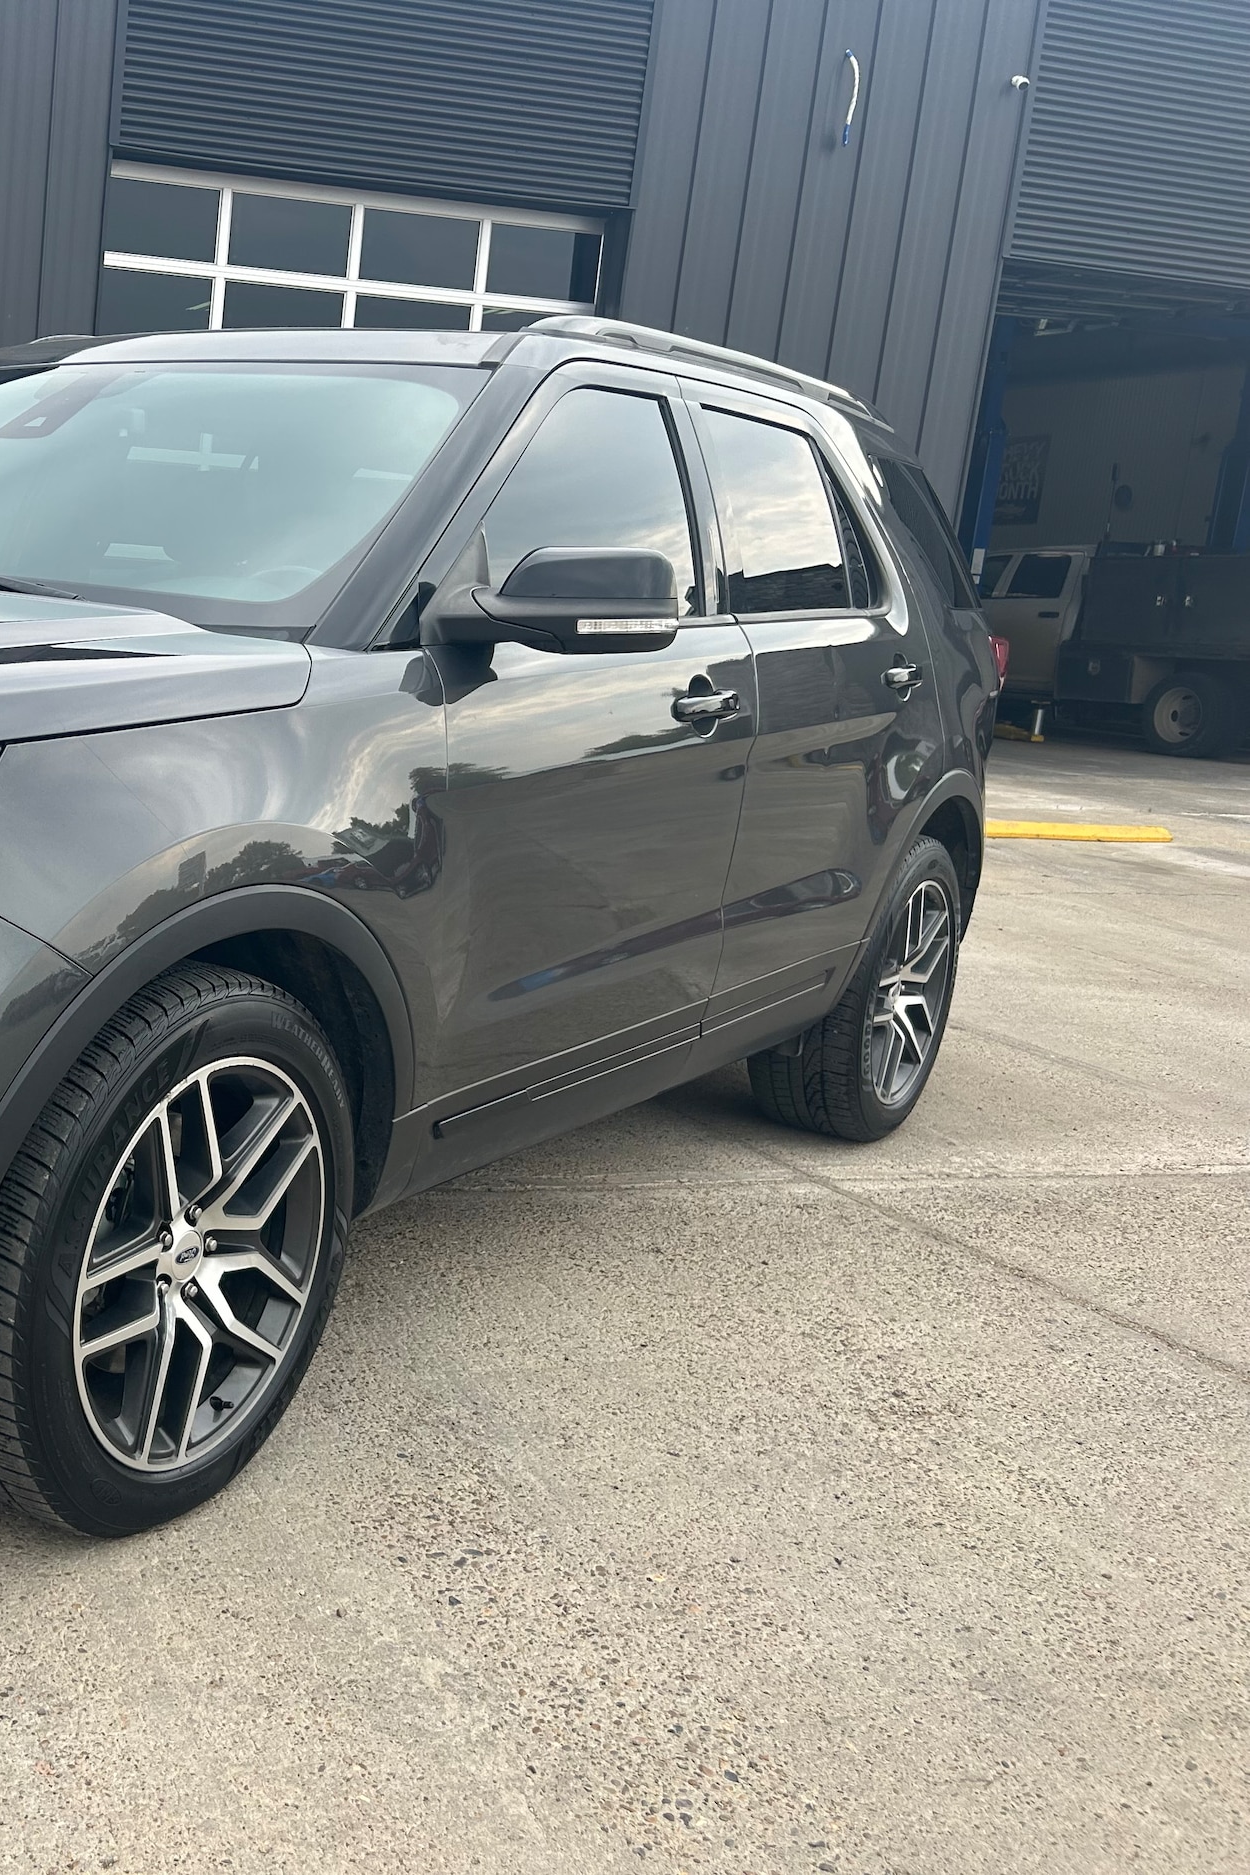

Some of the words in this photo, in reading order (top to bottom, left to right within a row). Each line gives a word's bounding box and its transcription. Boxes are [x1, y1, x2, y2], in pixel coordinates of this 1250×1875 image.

[1002, 442, 1047, 463] HEVY
[998, 462, 1041, 482] RUCK
[997, 482, 1038, 500] ONTH
[58, 1058, 169, 1278] ASSURANCE
